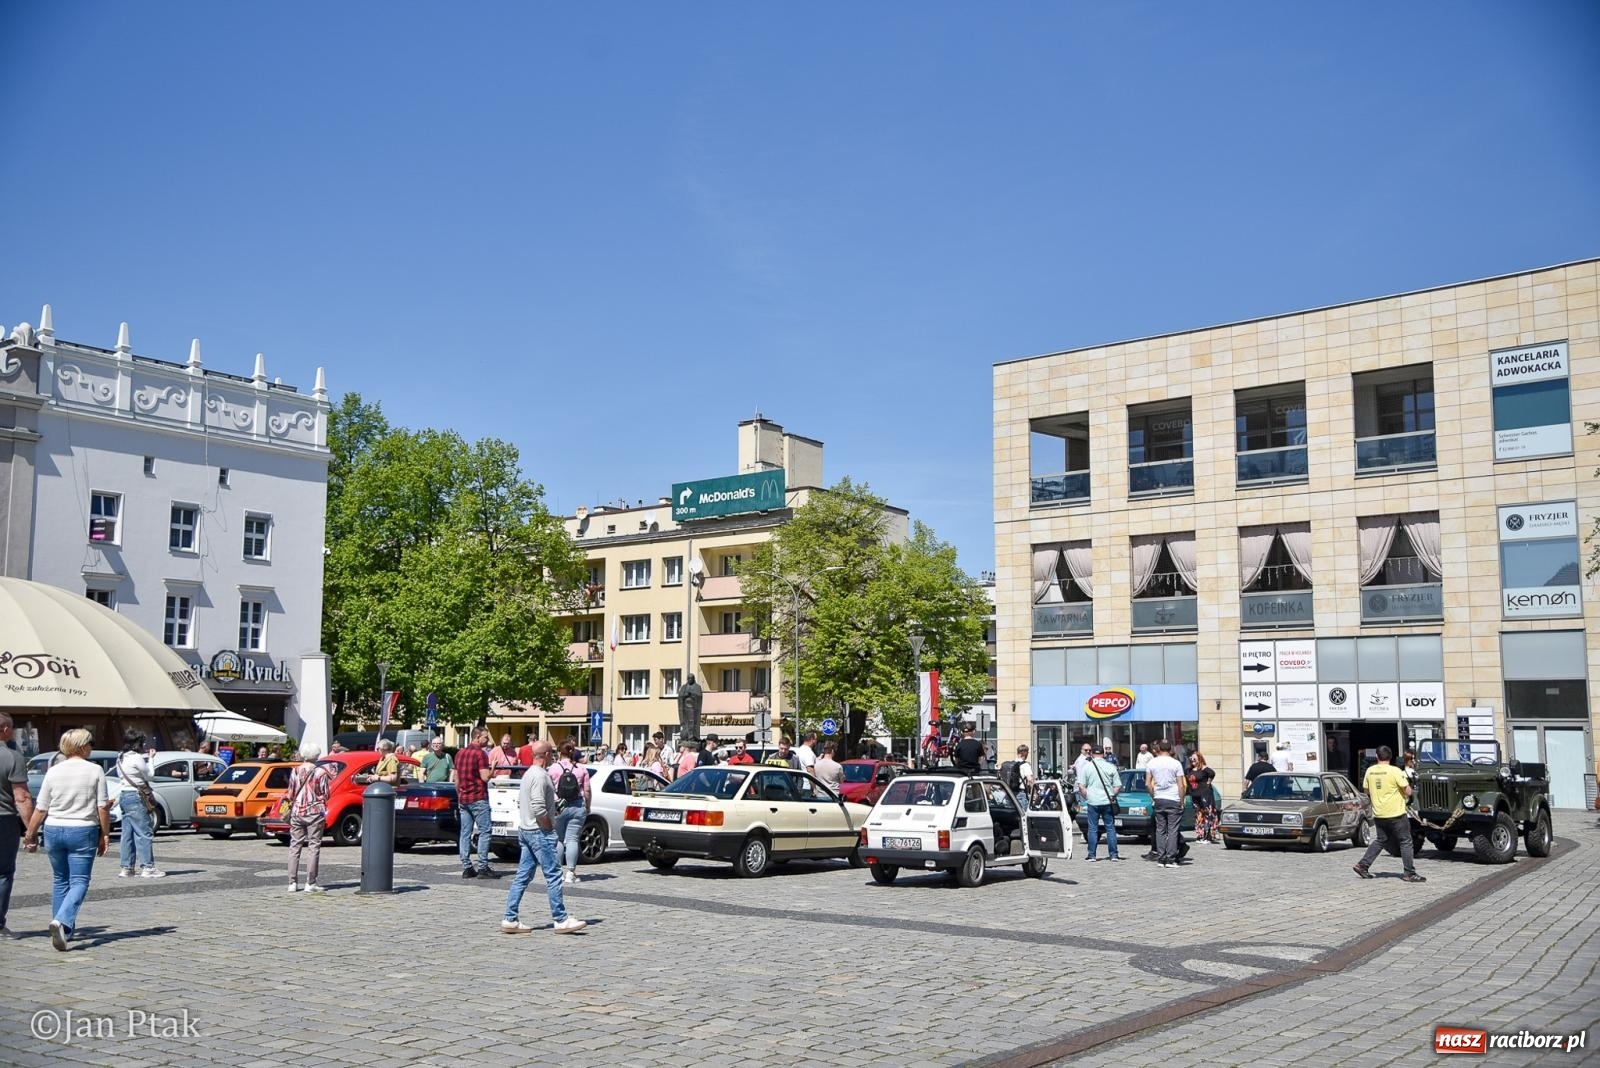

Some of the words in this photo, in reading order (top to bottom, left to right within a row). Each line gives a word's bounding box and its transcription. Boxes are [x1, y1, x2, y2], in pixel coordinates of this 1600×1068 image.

[1497, 349, 1560, 365] KANCELARIA
[1497, 361, 1561, 377] ADWOKACKA
[699, 488, 755, 504] McDonald's
[676, 507, 688, 515] 300
[1529, 512, 1568, 521] FRYZJER
[1249, 600, 1304, 616] KOFEINKA
[1248, 651, 1271, 659] PIĘTRO
[244, 658, 291, 684] Rynek
[68, 688, 88, 696] 1997
[1248, 690, 1272, 699] PIĘTRO
[1092, 698, 1127, 708] PEPCO
[1405, 697, 1437, 707] LODY
[899, 839, 921, 848] 76126
